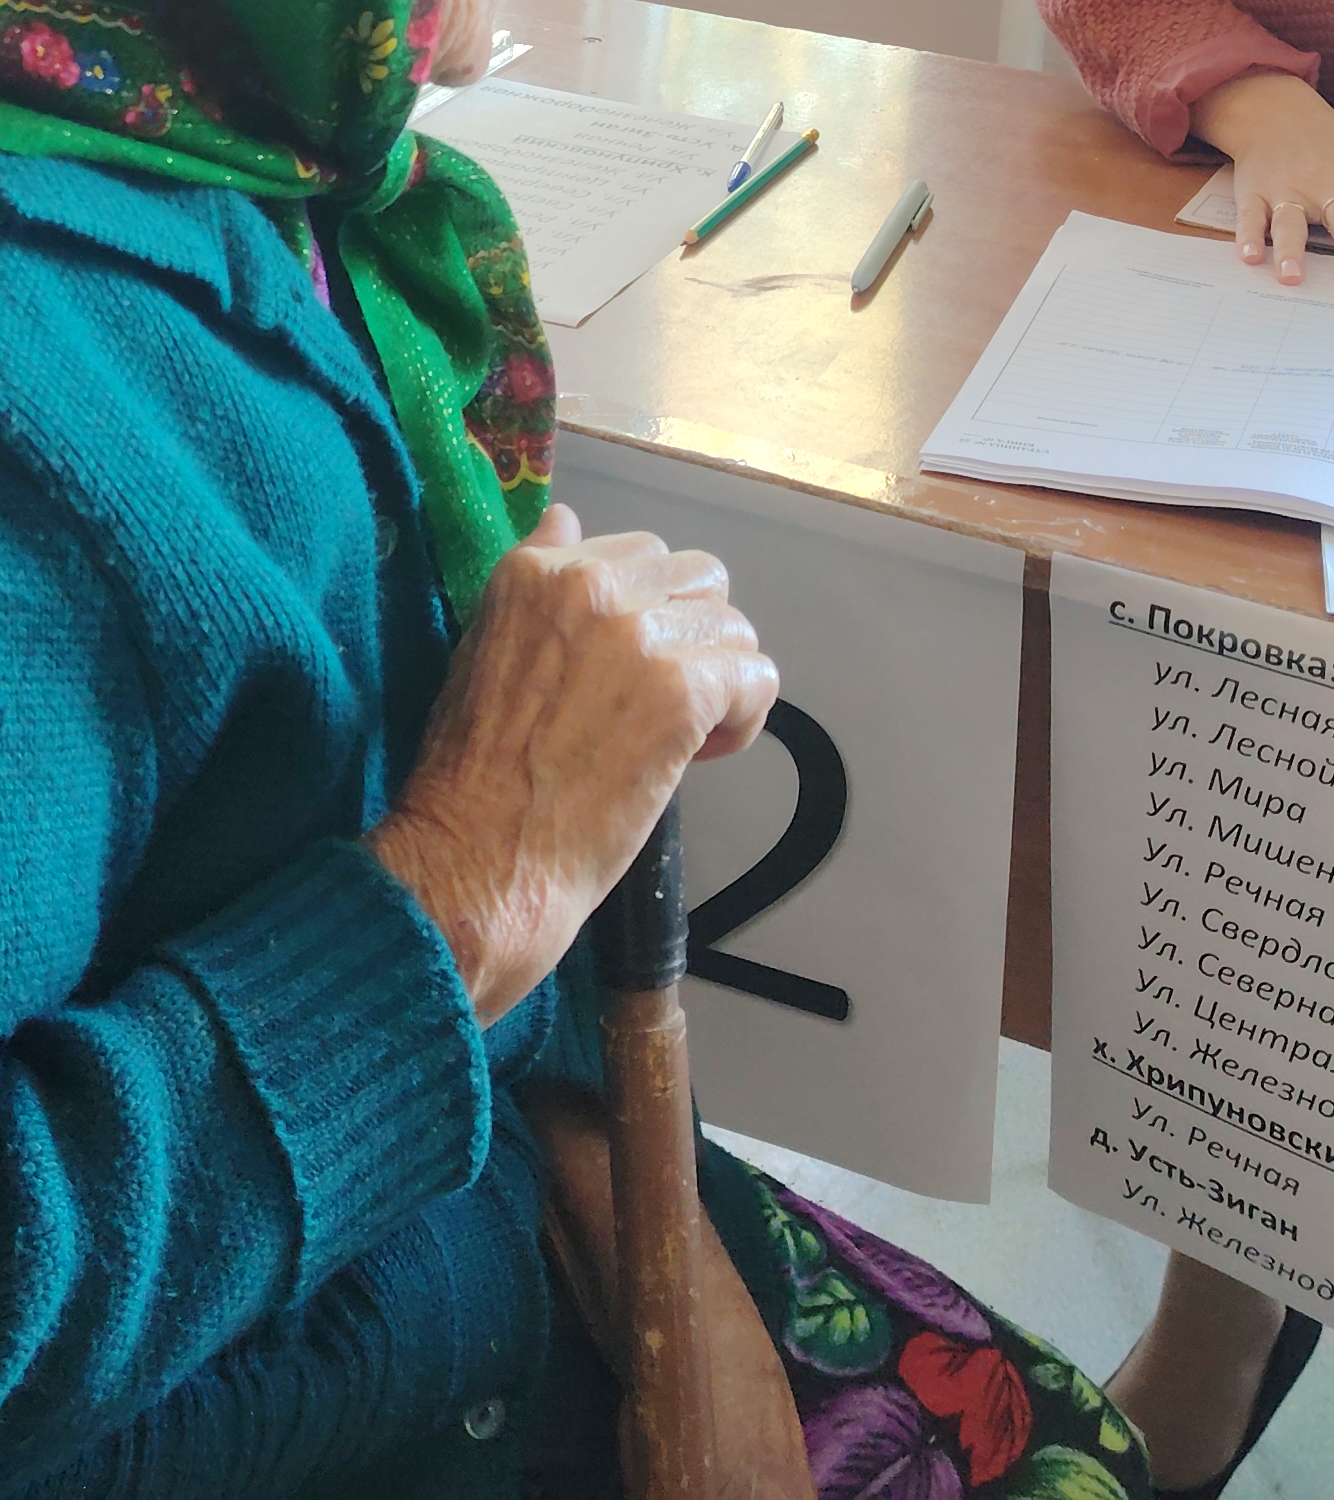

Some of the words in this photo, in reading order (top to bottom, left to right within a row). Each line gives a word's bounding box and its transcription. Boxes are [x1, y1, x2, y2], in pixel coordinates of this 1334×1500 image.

[480, 86, 698, 131] Железнодорожная
[573, 133, 658, 152] Речная
[590, 121, 716, 149] Усть-Зиган
[437, 134, 628, 176] Железнодорож
[472, 156, 610, 187] Центральн
[510, 136, 689, 174] Хрипуновский
[505, 191, 575, 211] Сверд
[513, 209, 560, 223] Речн
[1110, 600, 1134, 624] с.
[1154, 662, 1199, 693] ул.
[1151, 706, 1197, 738] ул.
[1148, 752, 1193, 784] ул.
[1208, 768, 1306, 824] Мира
[1146, 792, 1193, 831] Ул.
[687, 697, 849, 1022] 2
[1140, 882, 1186, 921] Ул.
[1143, 837, 1189, 876] Ул.
[1204, 862, 1325, 927] Речная
[1138, 926, 1183, 965] Ул.
[1135, 968, 1180, 1008] Ул.
[1092, 1037, 1116, 1063] х.
[1133, 1011, 1177, 1051] Ул.
[1132, 1097, 1174, 1137] Ул.
[1188, 1126, 1299, 1196] Речная
[1090, 1127, 1119, 1153] д.
[1129, 1138, 1299, 1242] Усть-Зиган
[1123, 1178, 1165, 1216] Ул.
